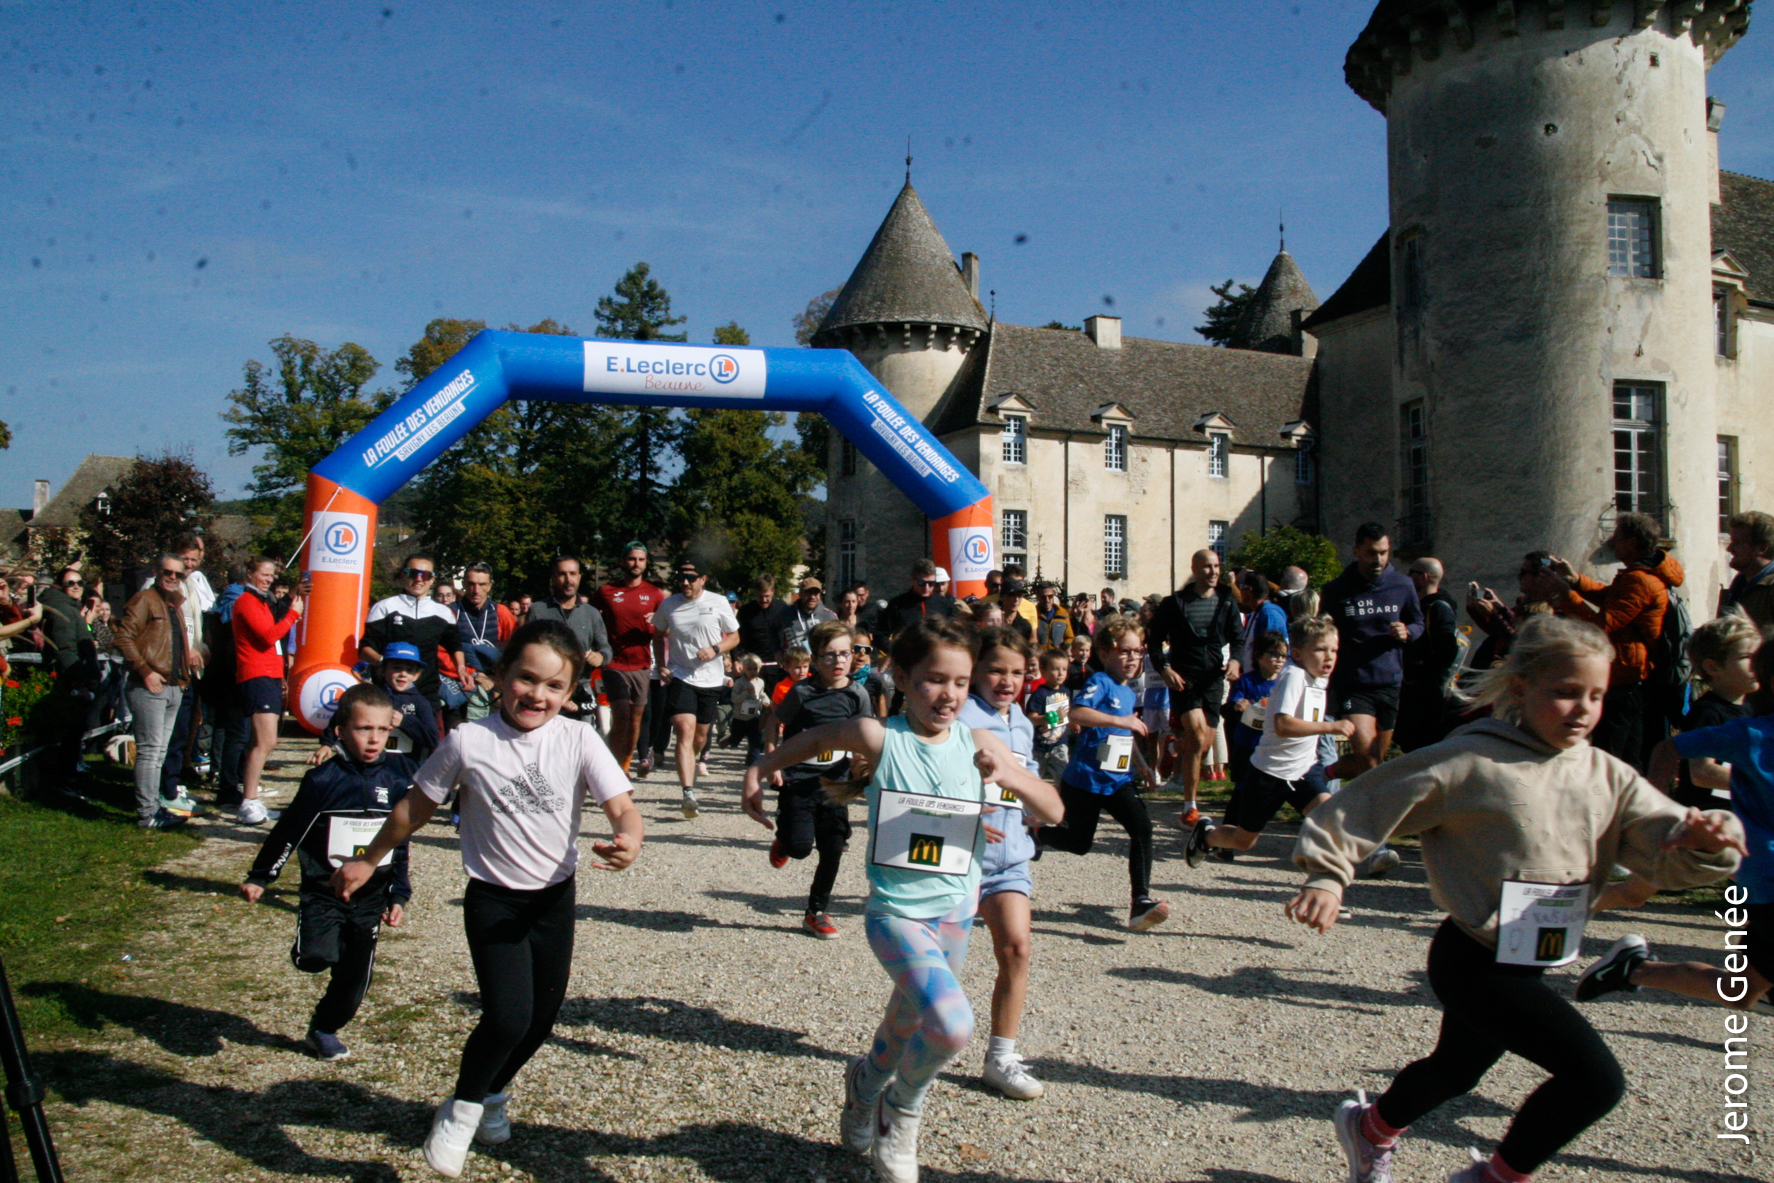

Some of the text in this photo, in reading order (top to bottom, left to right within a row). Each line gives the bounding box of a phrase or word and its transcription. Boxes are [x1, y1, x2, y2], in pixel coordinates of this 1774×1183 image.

[606, 356, 706, 376] E.Leclerc
[645, 374, 705, 391] Beaune
[362, 369, 475, 467] LA FOULÉE DES VENDANGES
[398, 403, 463, 459] SAVIGNY LES BEAUNE
[862, 390, 880, 404] LA
[898, 425, 920, 443] DES
[913, 438, 960, 482] VENDANGES
[874, 421, 930, 475] SAVIGNY LES BEAUNE
[322, 556, 357, 565] E.Leclerc
[1357, 599, 1373, 607] ON
[1359, 605, 1398, 615] BOARD
[898, 797, 905, 805] LA
